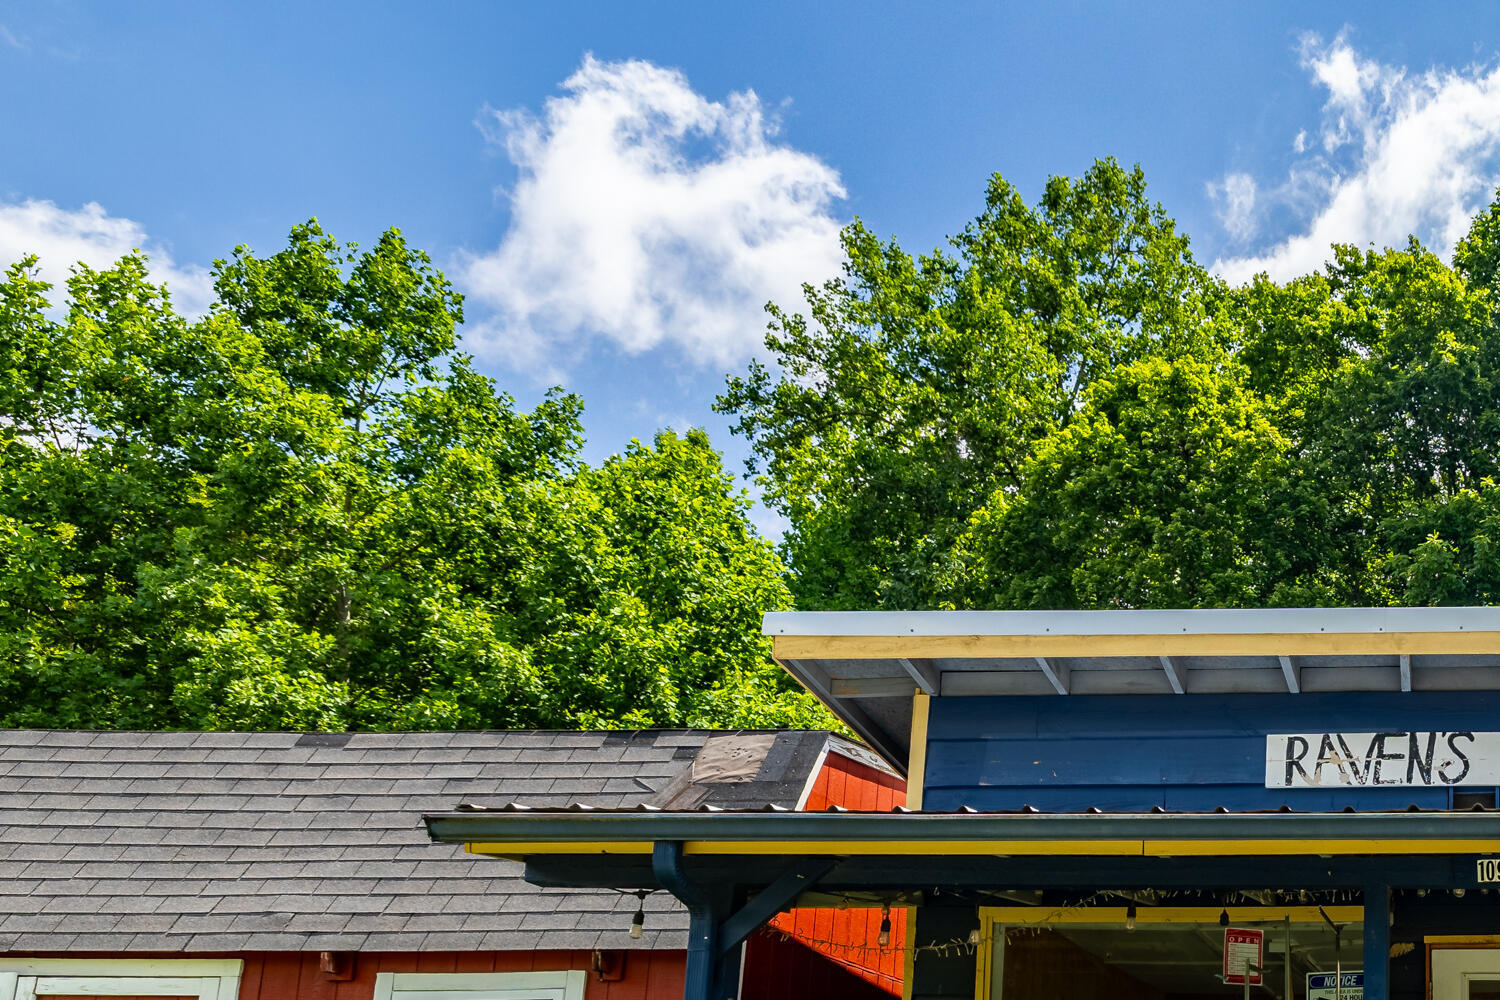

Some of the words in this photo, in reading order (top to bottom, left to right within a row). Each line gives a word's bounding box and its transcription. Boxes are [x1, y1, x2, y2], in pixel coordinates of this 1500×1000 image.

[1285, 732, 1475, 786] RAVEN'S
[1229, 936, 1259, 944] OPEN
[1324, 976, 1357, 986] NOICE
